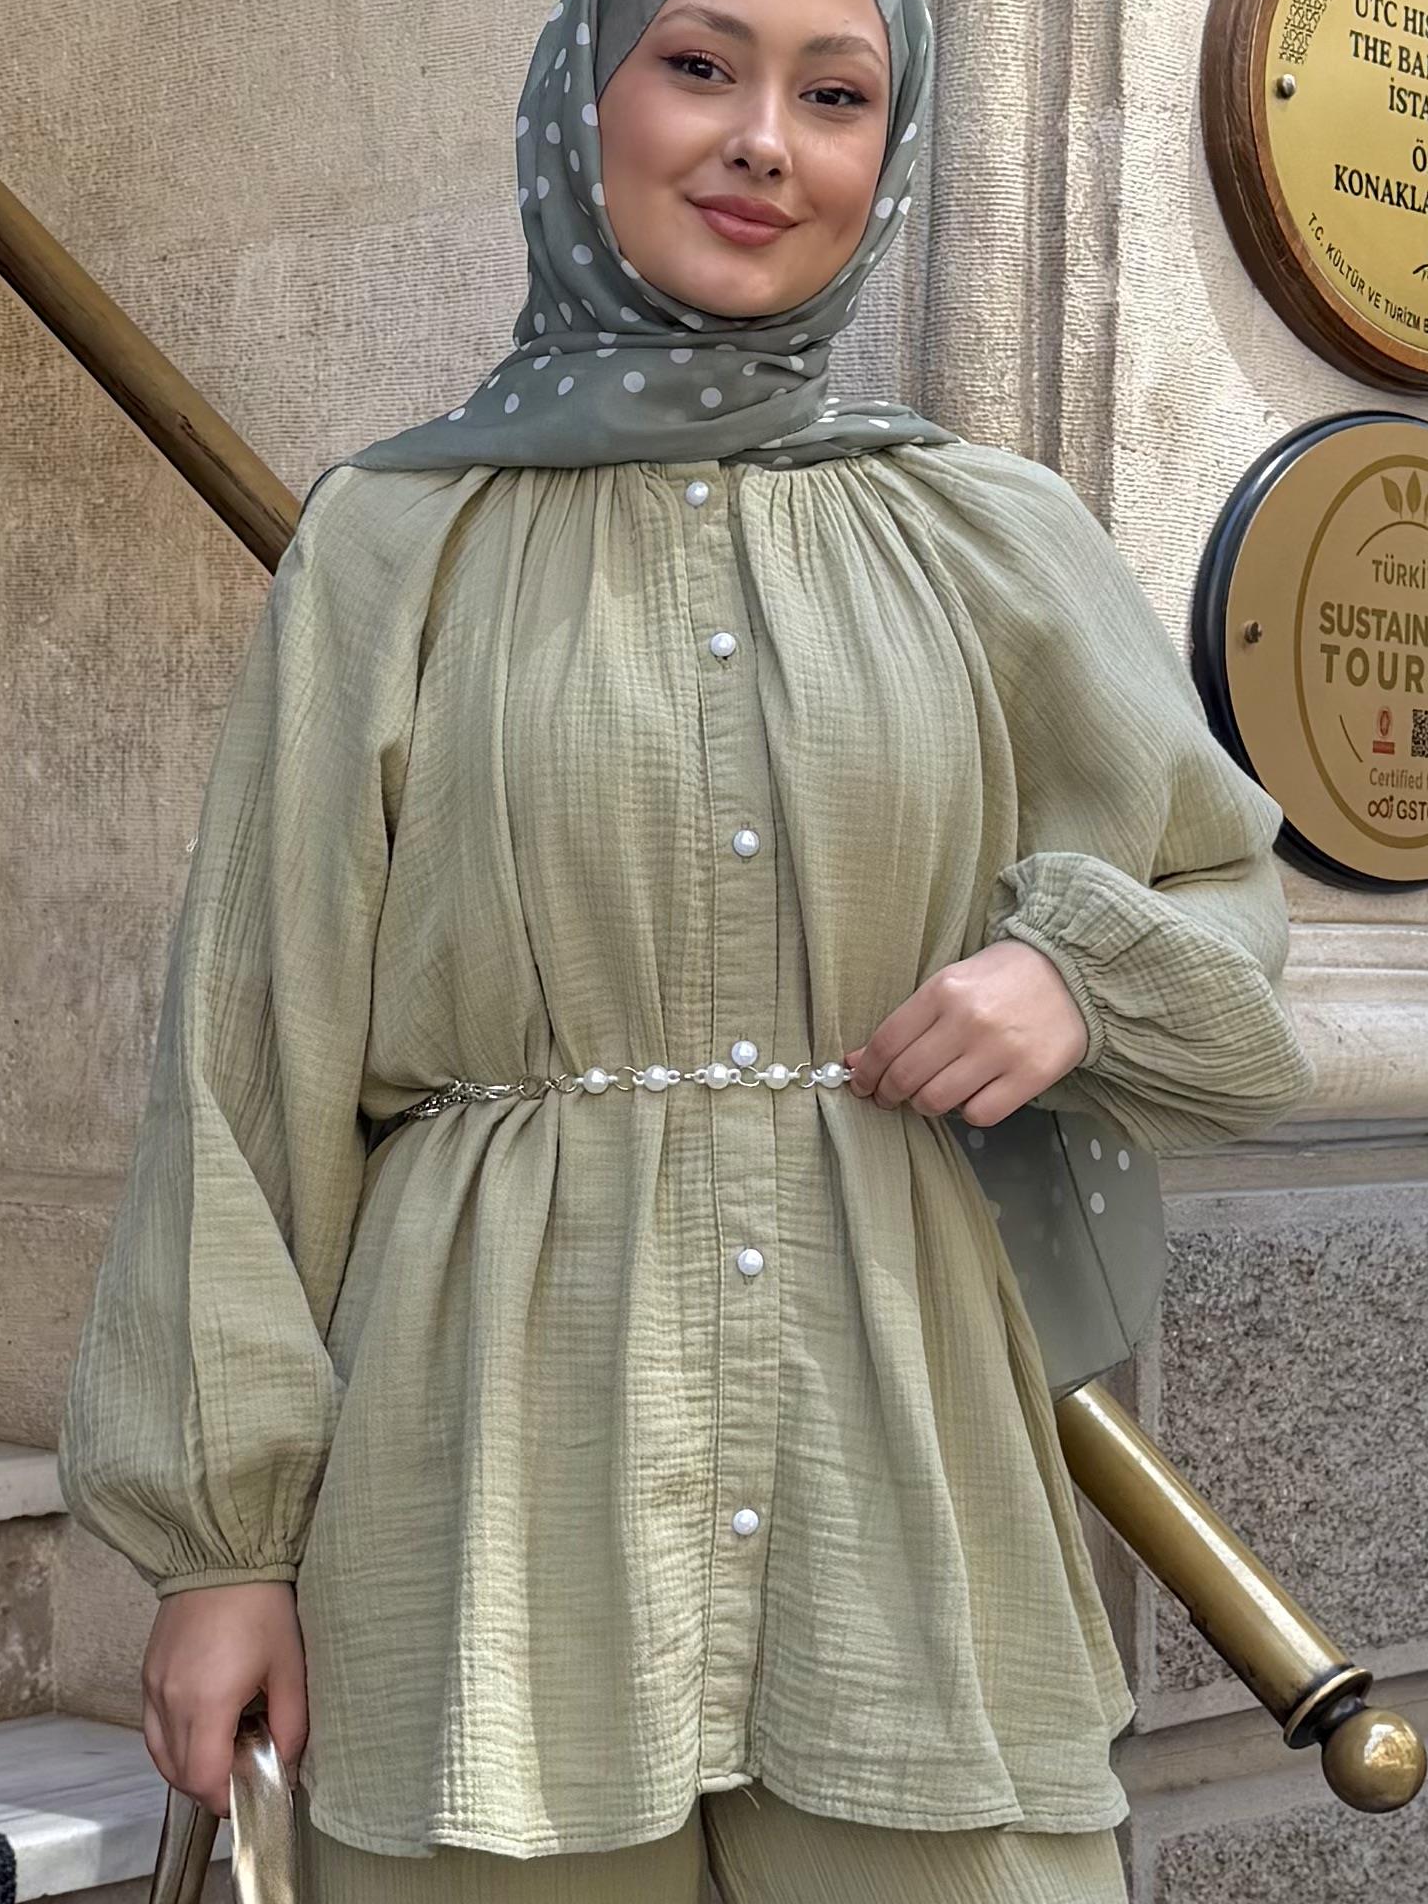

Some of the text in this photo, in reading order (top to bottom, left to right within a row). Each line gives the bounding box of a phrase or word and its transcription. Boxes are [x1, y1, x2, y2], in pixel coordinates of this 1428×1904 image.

[1349, 29, 1393, 68] THE
[1308, 212, 1324, 247] T.C.
[1325, 242, 1366, 296] KÜLTÜR
[1368, 286, 1382, 309] VE
[1384, 298, 1421, 330] TURİZM
[1369, 767, 1423, 790] Certified
